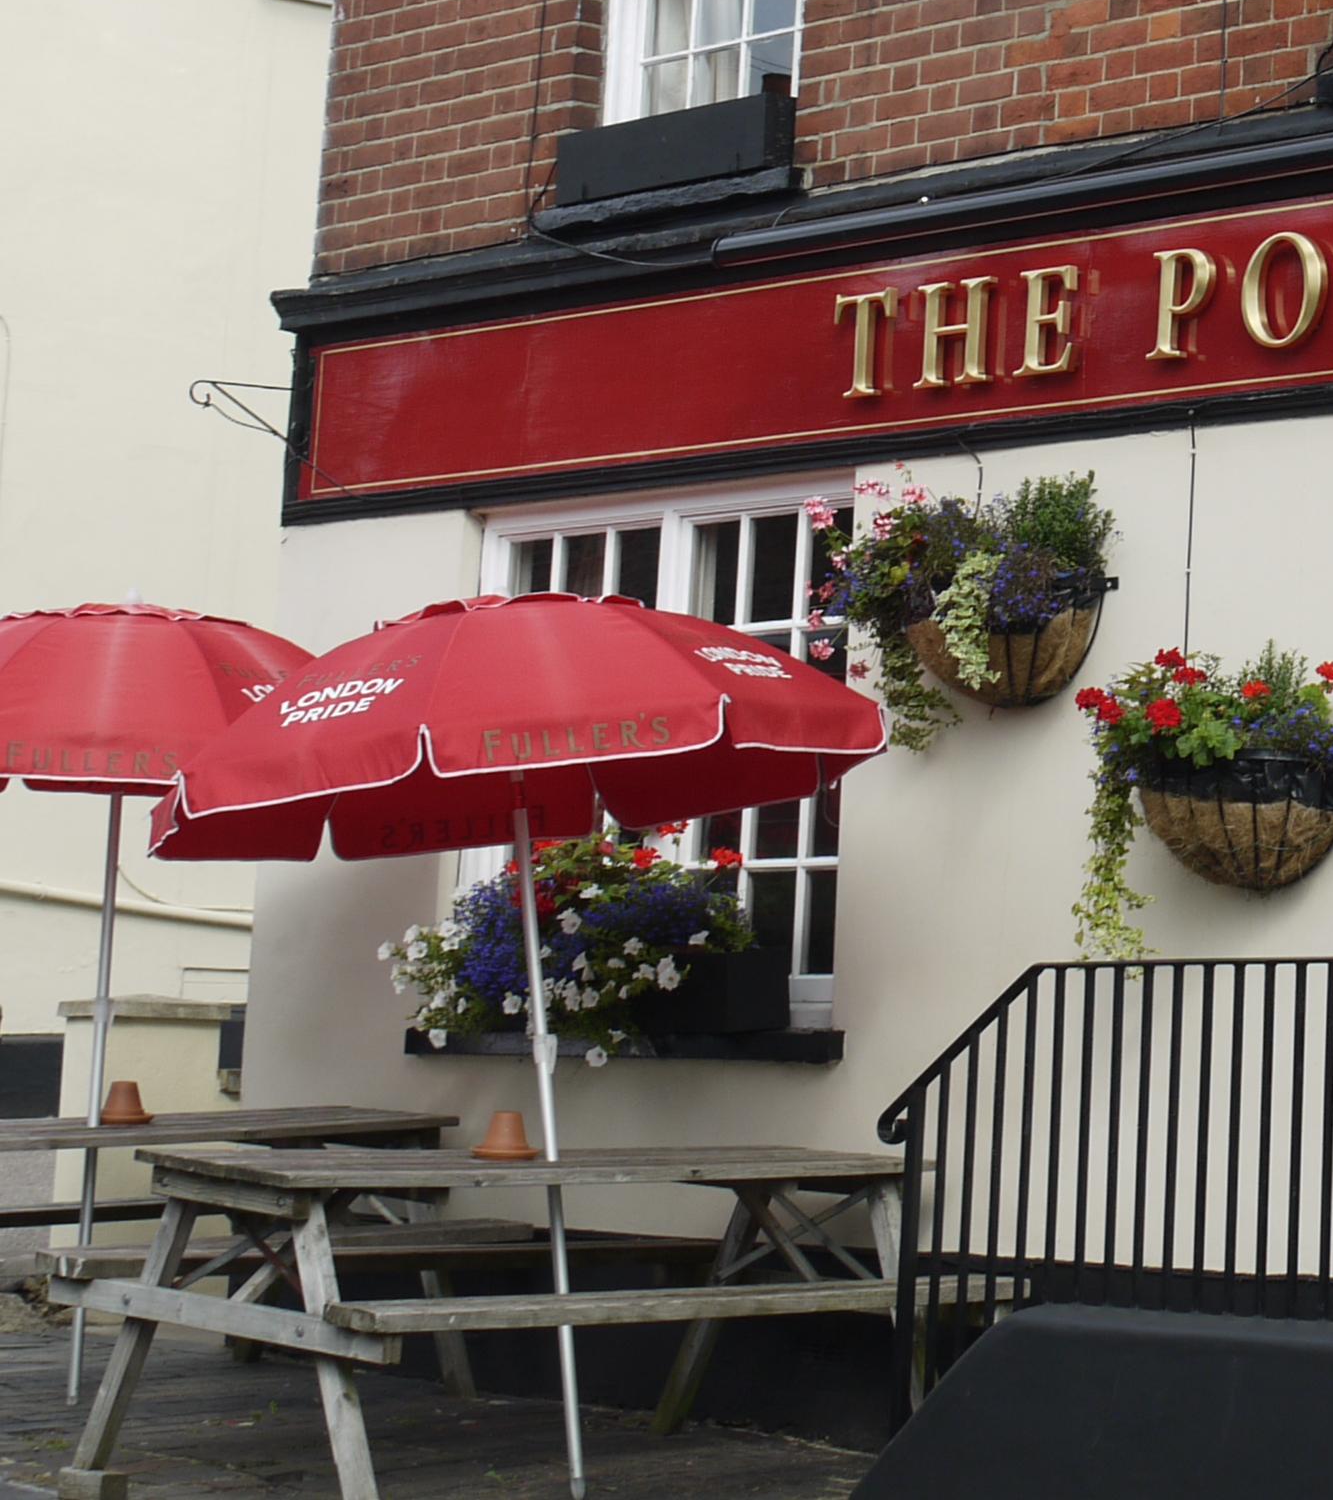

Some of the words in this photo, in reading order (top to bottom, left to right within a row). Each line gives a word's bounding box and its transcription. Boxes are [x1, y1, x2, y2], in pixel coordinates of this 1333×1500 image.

[834, 264, 1079, 398] THE
[280, 678, 404, 715] LONDON
[280, 696, 376, 727] PRIDE
[483, 712, 671, 763] FULLER'S
[6, 740, 178, 776] FULLER'S
